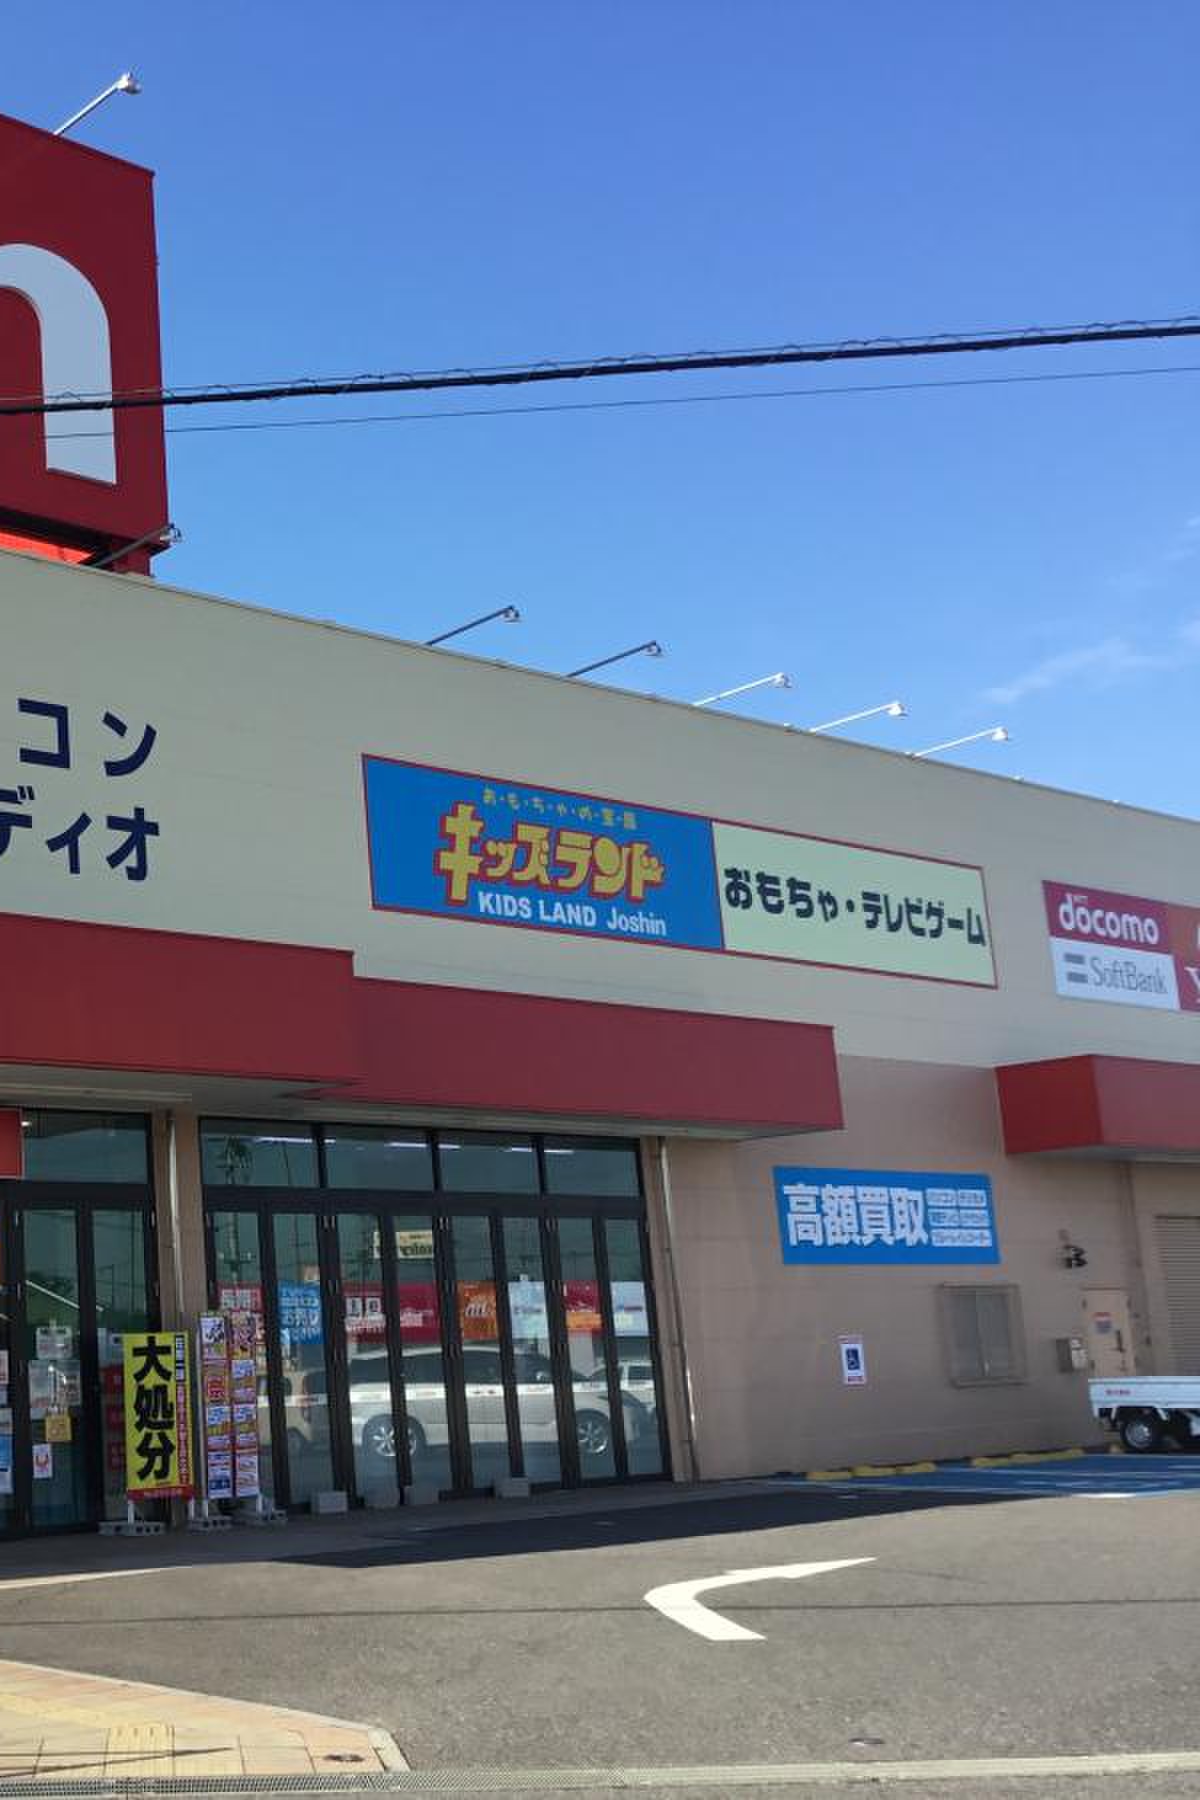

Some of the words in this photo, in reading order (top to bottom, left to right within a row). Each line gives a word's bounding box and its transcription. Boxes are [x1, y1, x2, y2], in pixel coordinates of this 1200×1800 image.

[434, 801, 666, 905] キッズランド
[478, 891, 532, 919] KIDS
[539, 900, 597, 928] LAND
[607, 906, 667, 936] Joshin
[1058, 893, 1160, 945] docomo
[1089, 957, 1169, 994] SoftBank
[783, 1182, 929, 1247] 高額買取
[132, 1335, 176, 1482] 大処分
